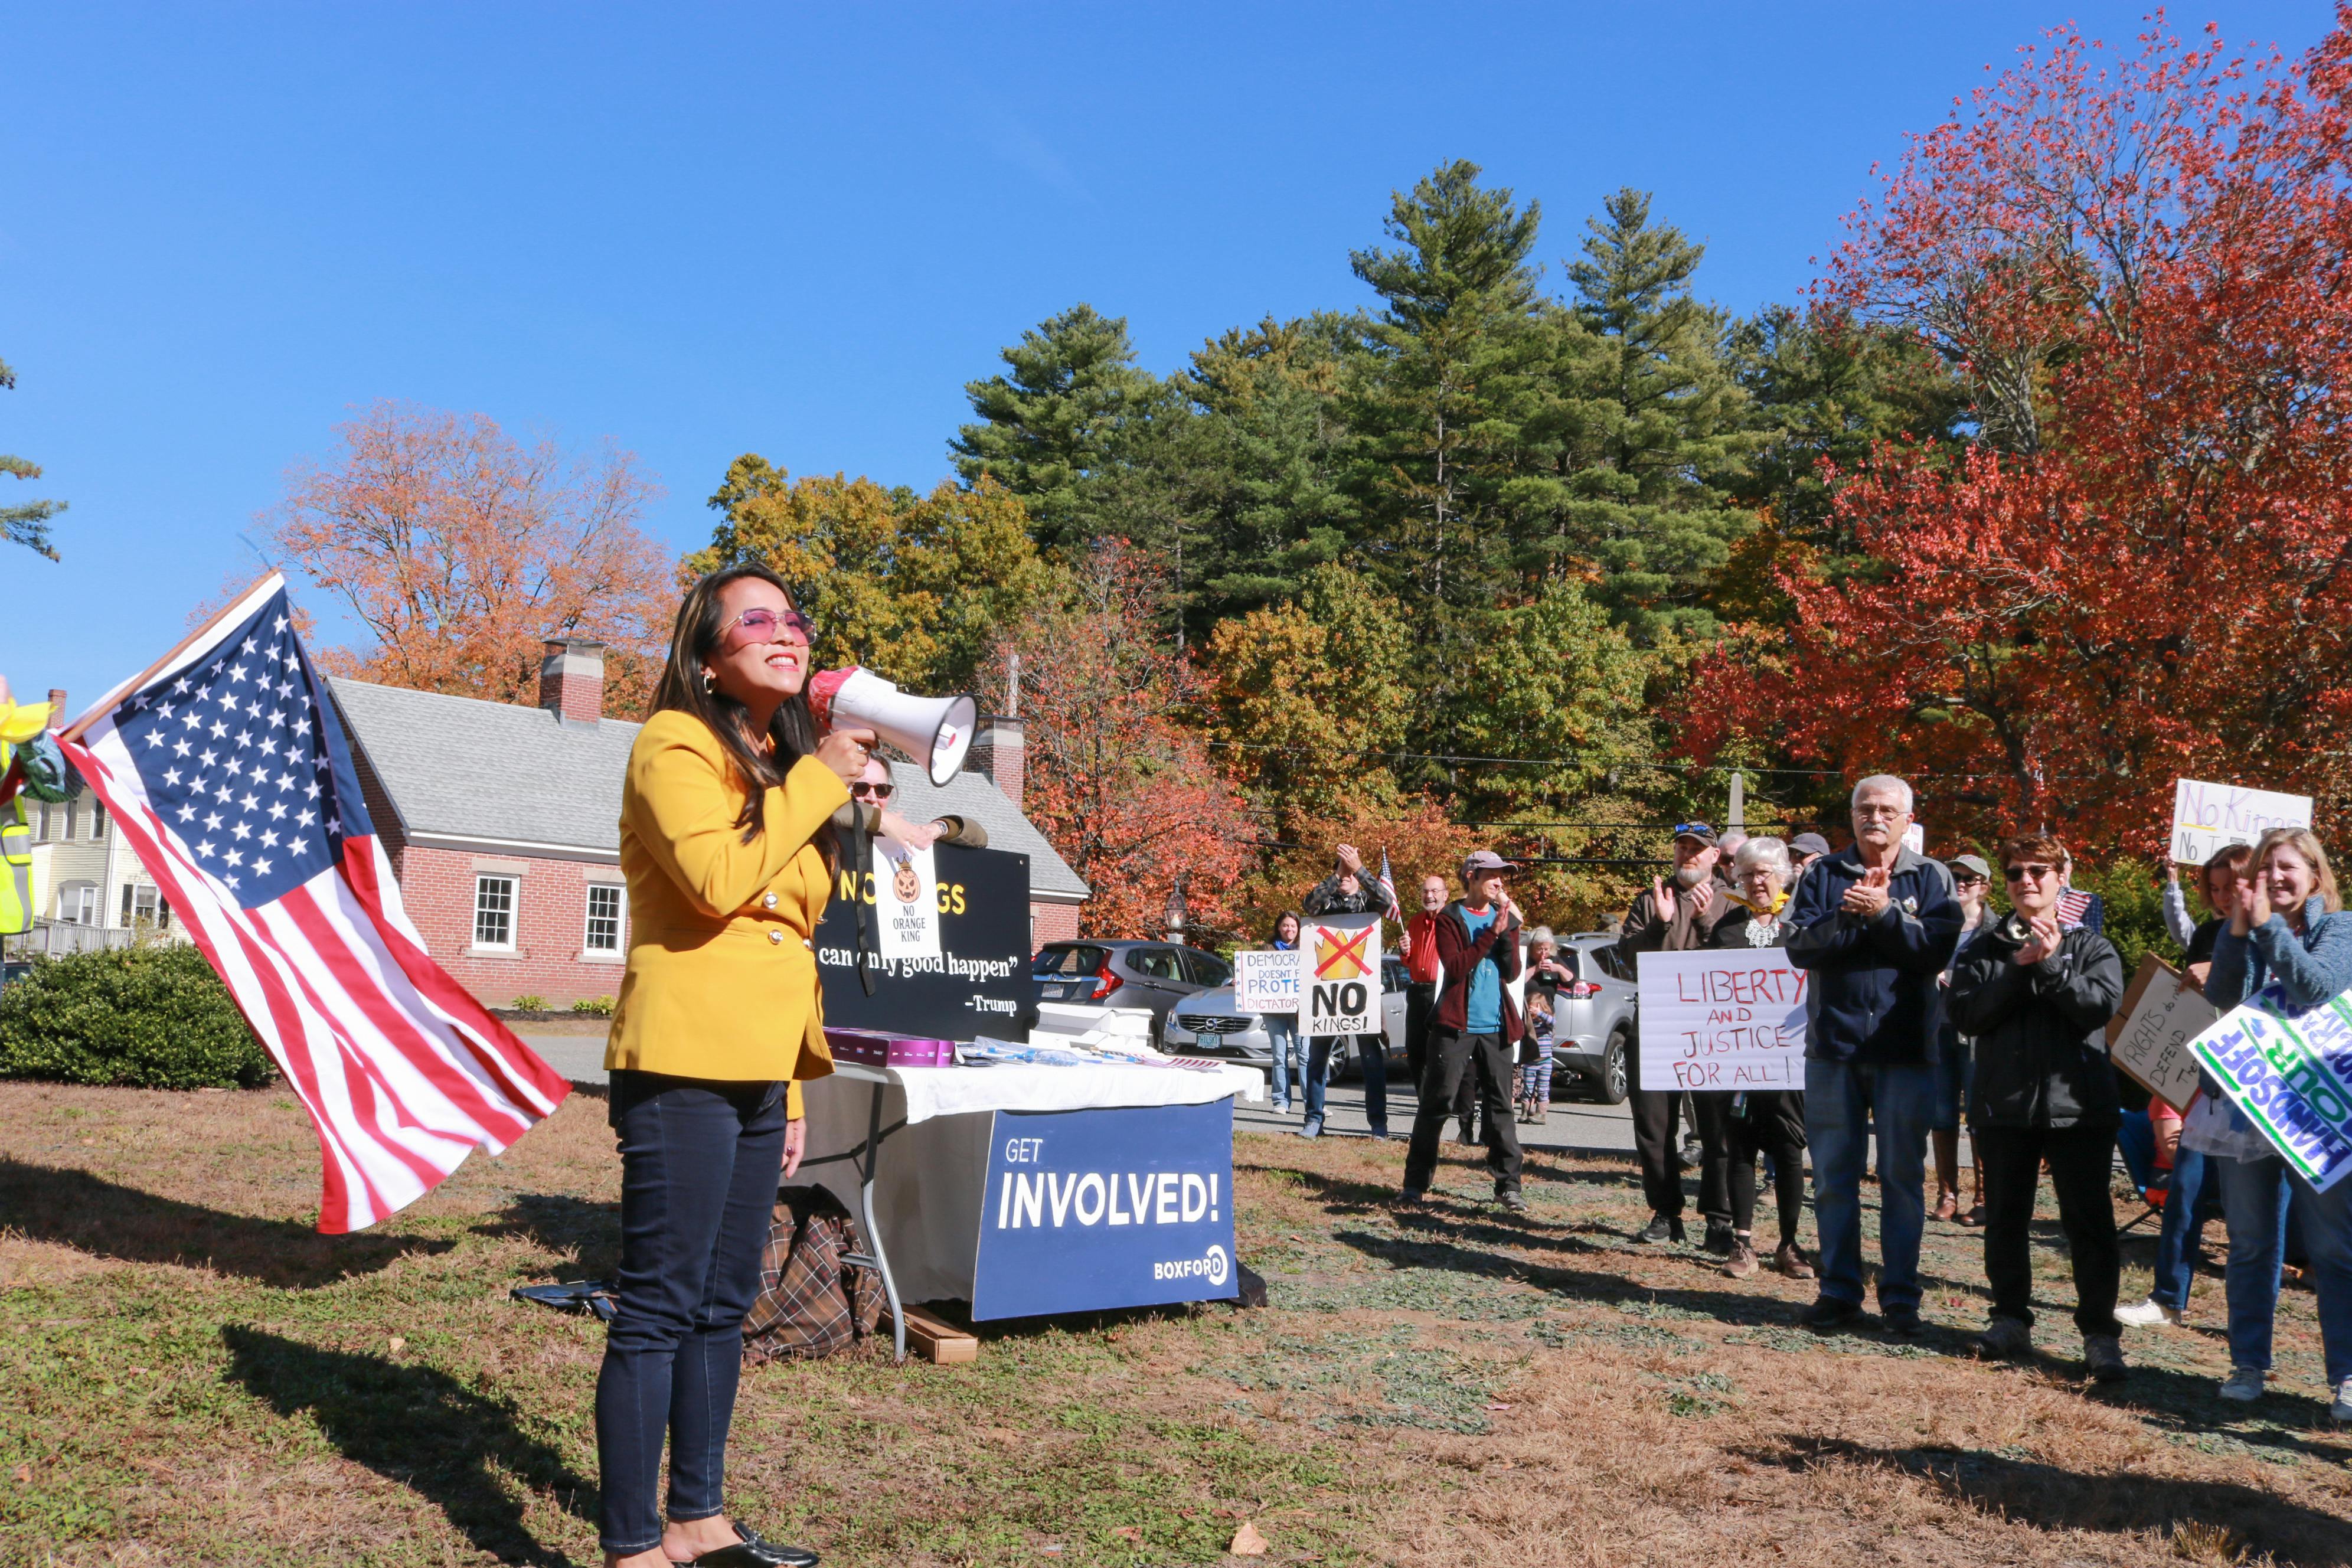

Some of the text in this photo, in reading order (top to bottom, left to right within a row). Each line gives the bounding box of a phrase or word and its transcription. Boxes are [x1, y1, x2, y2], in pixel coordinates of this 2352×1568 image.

[2180, 783, 2219, 826] No
[2178, 831, 2198, 861] No
[893, 917, 926, 930] ORANGE
[903, 905, 914, 916] NO
[901, 930, 920, 942] KING
[818, 947, 854, 966] can
[1248, 979, 1300, 994] PROTE
[1258, 969, 1292, 979] DOESNT
[1678, 969, 1809, 1005] LIBERTY
[1247, 998, 1299, 1009] DICTATOR
[1312, 982, 1367, 1017] NO
[1312, 1016, 1368, 1033] KINGS!
[1707, 1007, 1752, 1025] AND
[1681, 1025, 1792, 1059] JUSTICE
[2124, 1009, 2166, 1066] RIGHTS
[2150, 1030, 2186, 1087] DEFEND
[1672, 1061, 1721, 1088] FOR
[2266, 1038, 2347, 1123] OUR
[1005, 1138, 1043, 1163] GET
[998, 1172, 1219, 1229] INVOLVED!
[1154, 1254, 1225, 1282] BOXFORD
